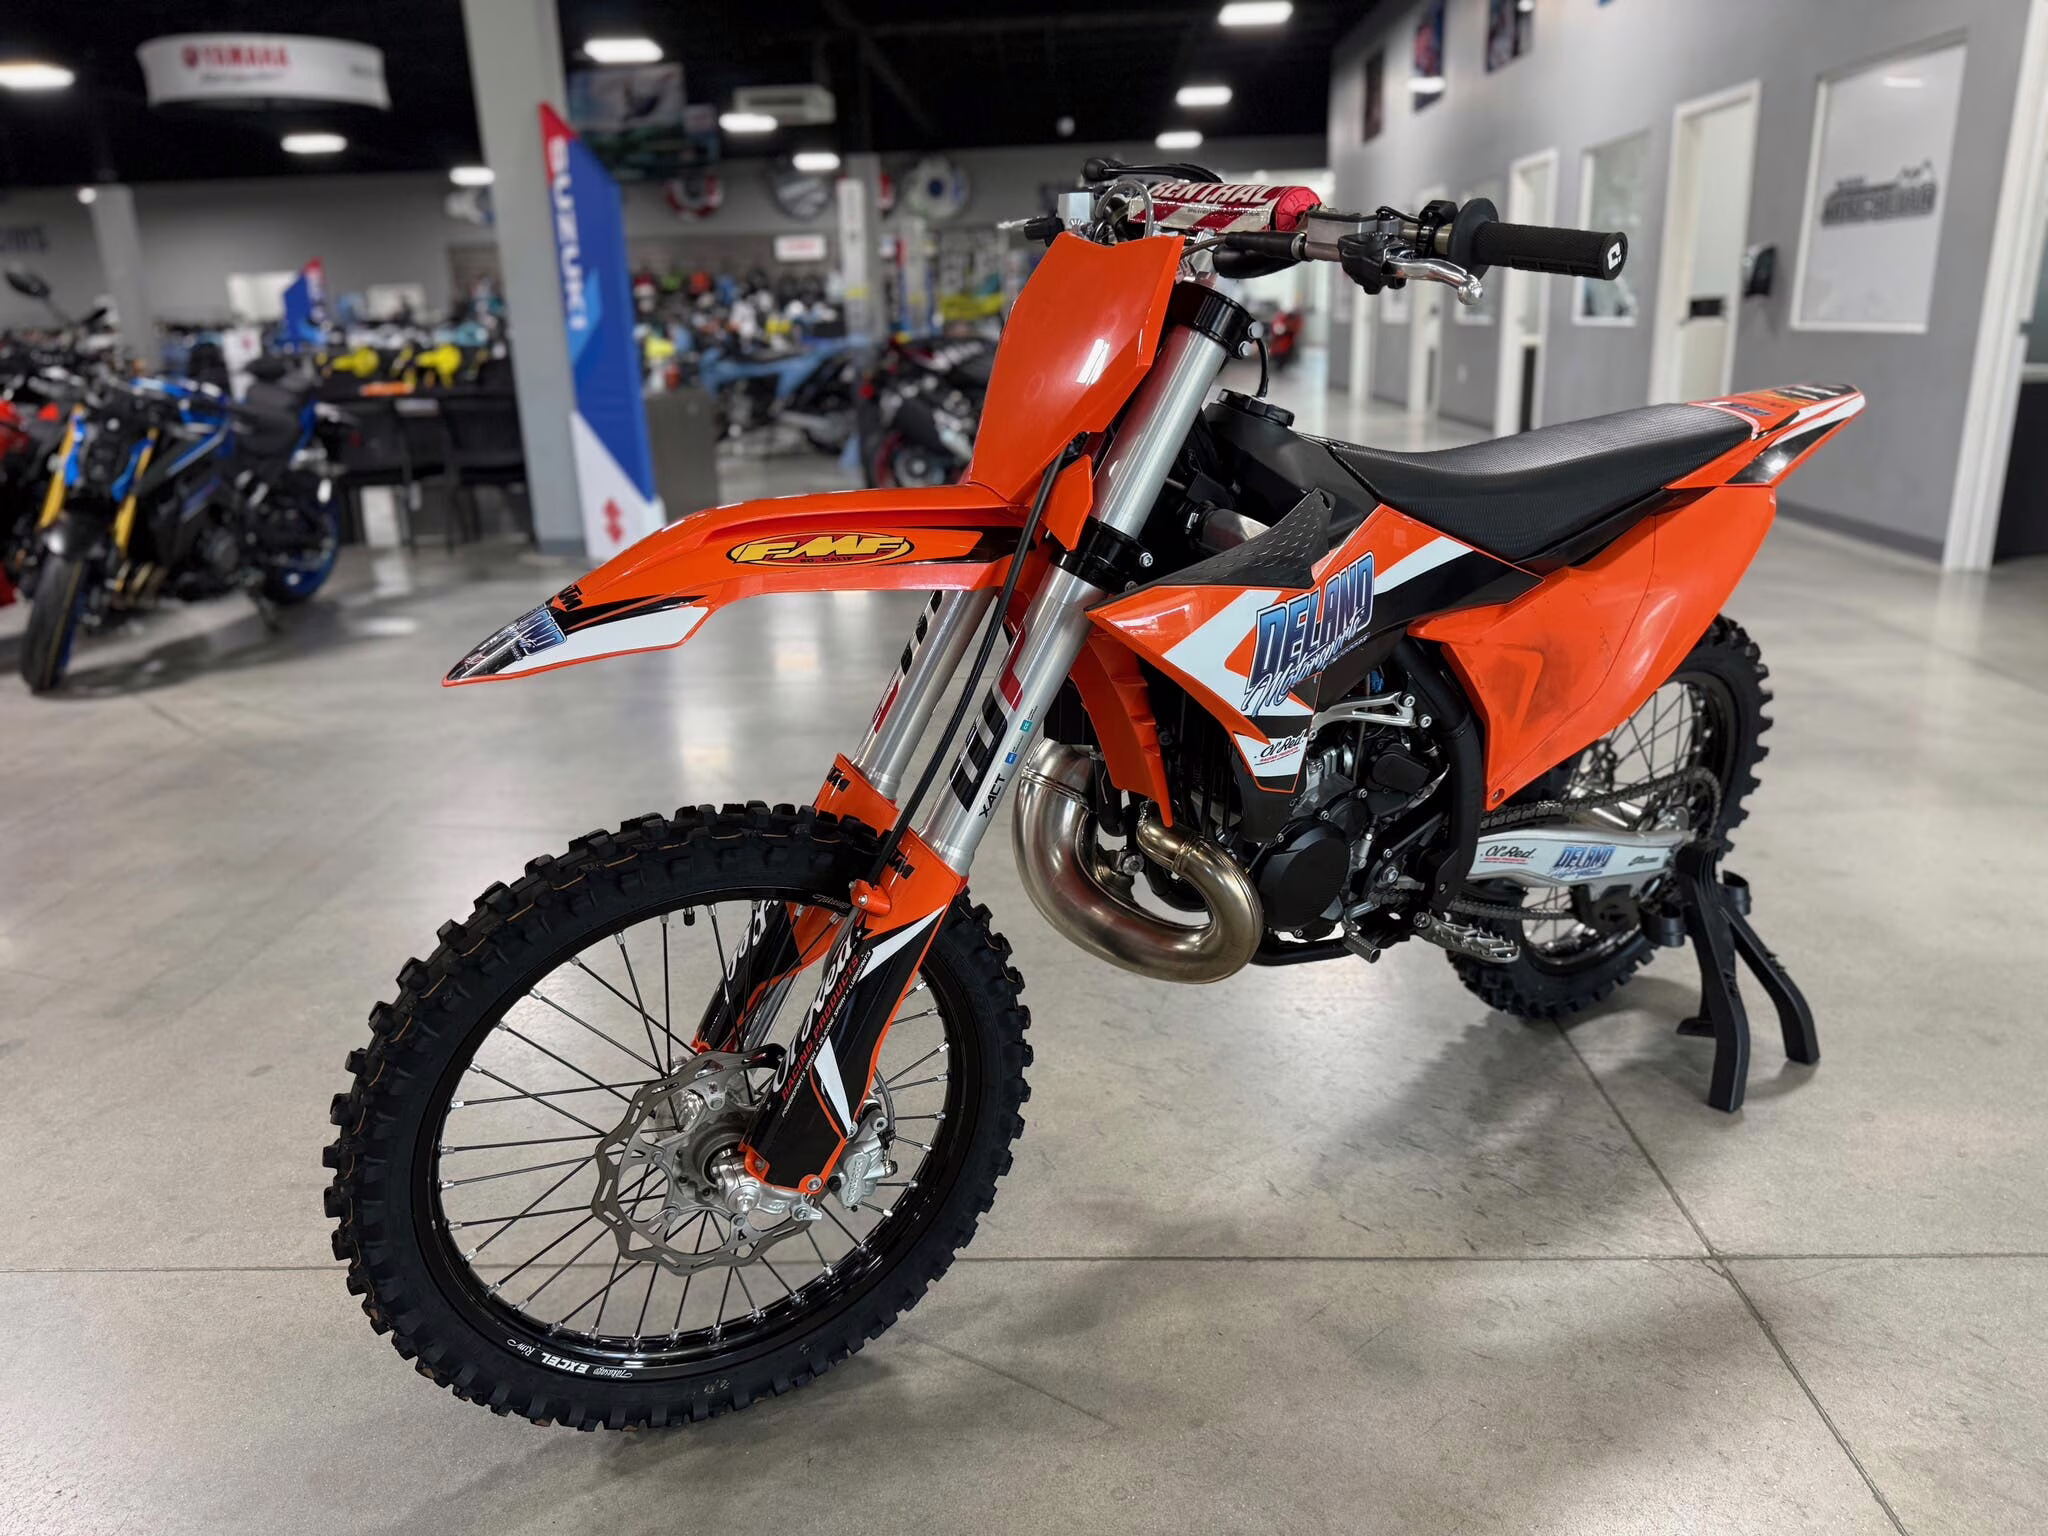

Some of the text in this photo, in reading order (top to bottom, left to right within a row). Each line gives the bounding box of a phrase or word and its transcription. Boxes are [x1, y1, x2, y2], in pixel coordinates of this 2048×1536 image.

[1150, 182, 1273, 204] RENTHAL
[548, 135, 588, 330] SUZUKI
[732, 534, 907, 564] FMF
[1246, 551, 1374, 695] DELAND
[978, 773, 1006, 818] XACT
[1553, 844, 1616, 868] DELAND
[782, 954, 859, 1101] RACING PRODUCTS
[782, 1071, 806, 1118] POWERSPORTS
[848, 951, 871, 989] LUBRICANTS
[540, 1352, 591, 1374] EXCEL
